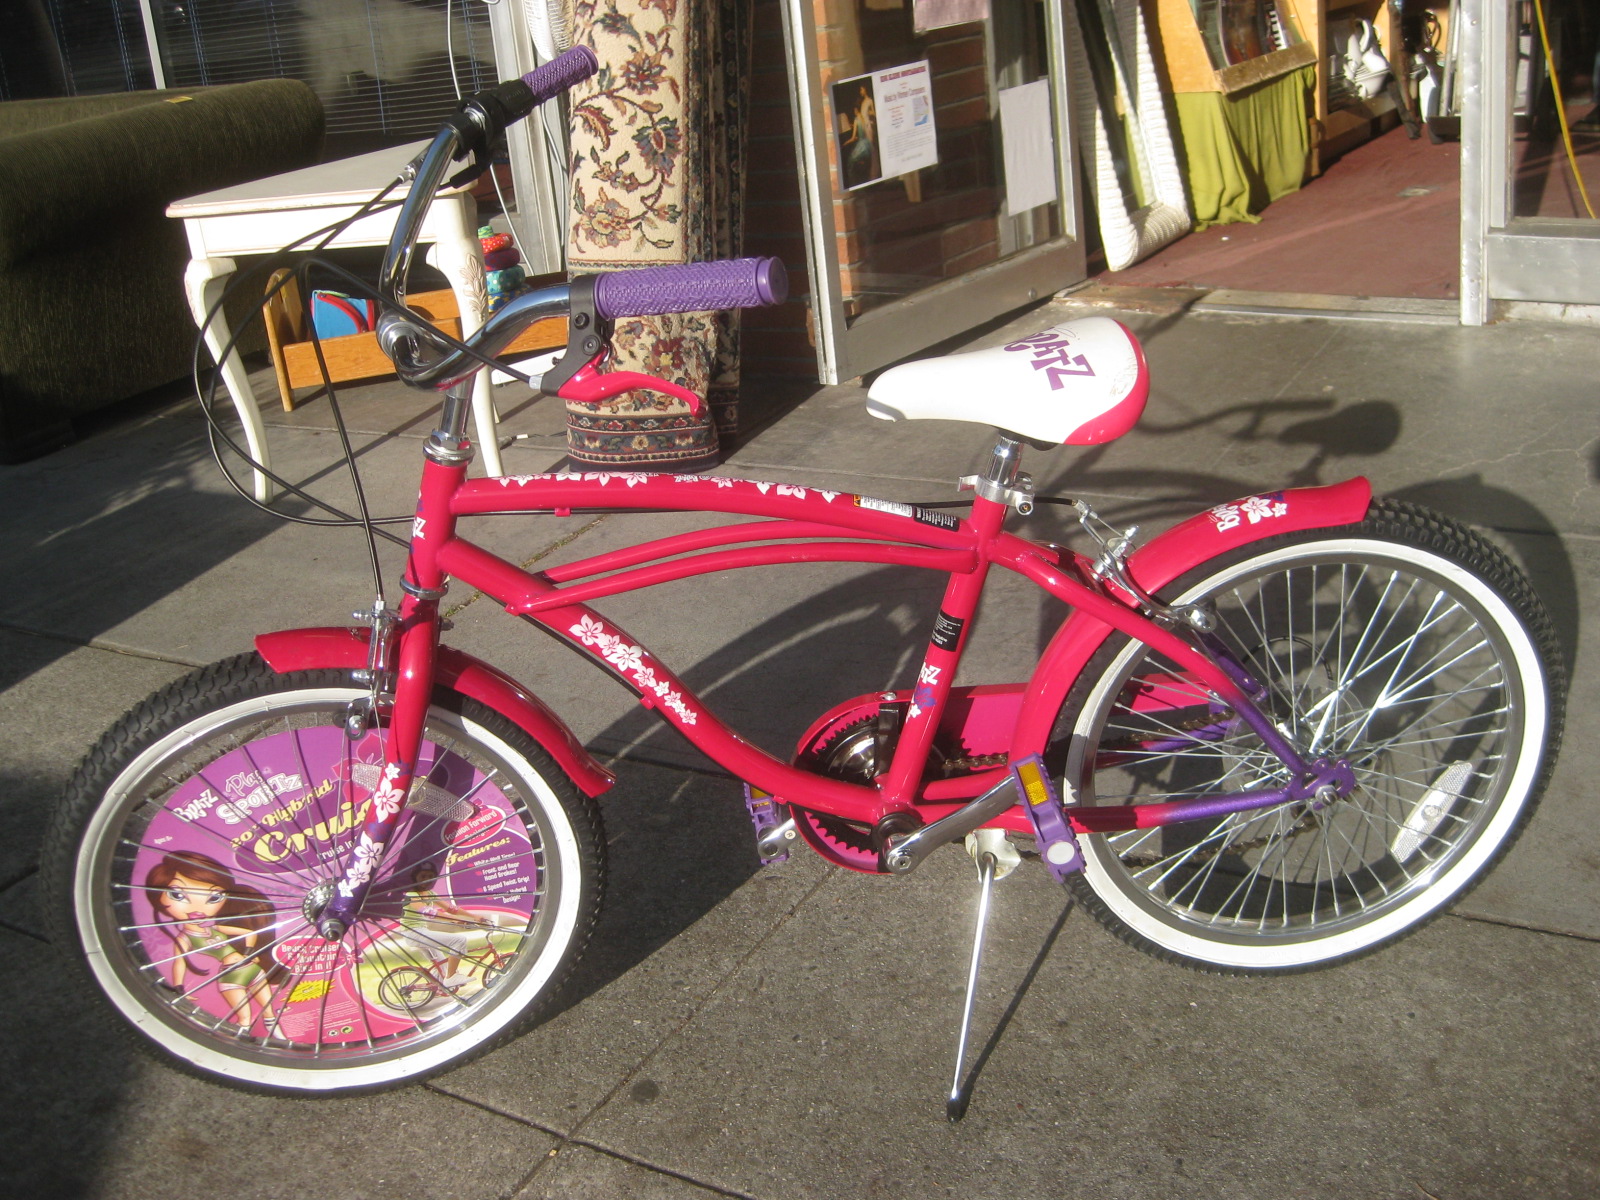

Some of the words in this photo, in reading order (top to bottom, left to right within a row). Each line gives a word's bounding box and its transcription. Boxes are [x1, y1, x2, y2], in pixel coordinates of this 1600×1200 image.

[1003, 326, 1096, 391] RATZ
[225, 769, 263, 797] Play
[260, 778, 334, 828] Hybrid
[468, 810, 498, 830] Forward
[445, 836, 511, 866] Features:
